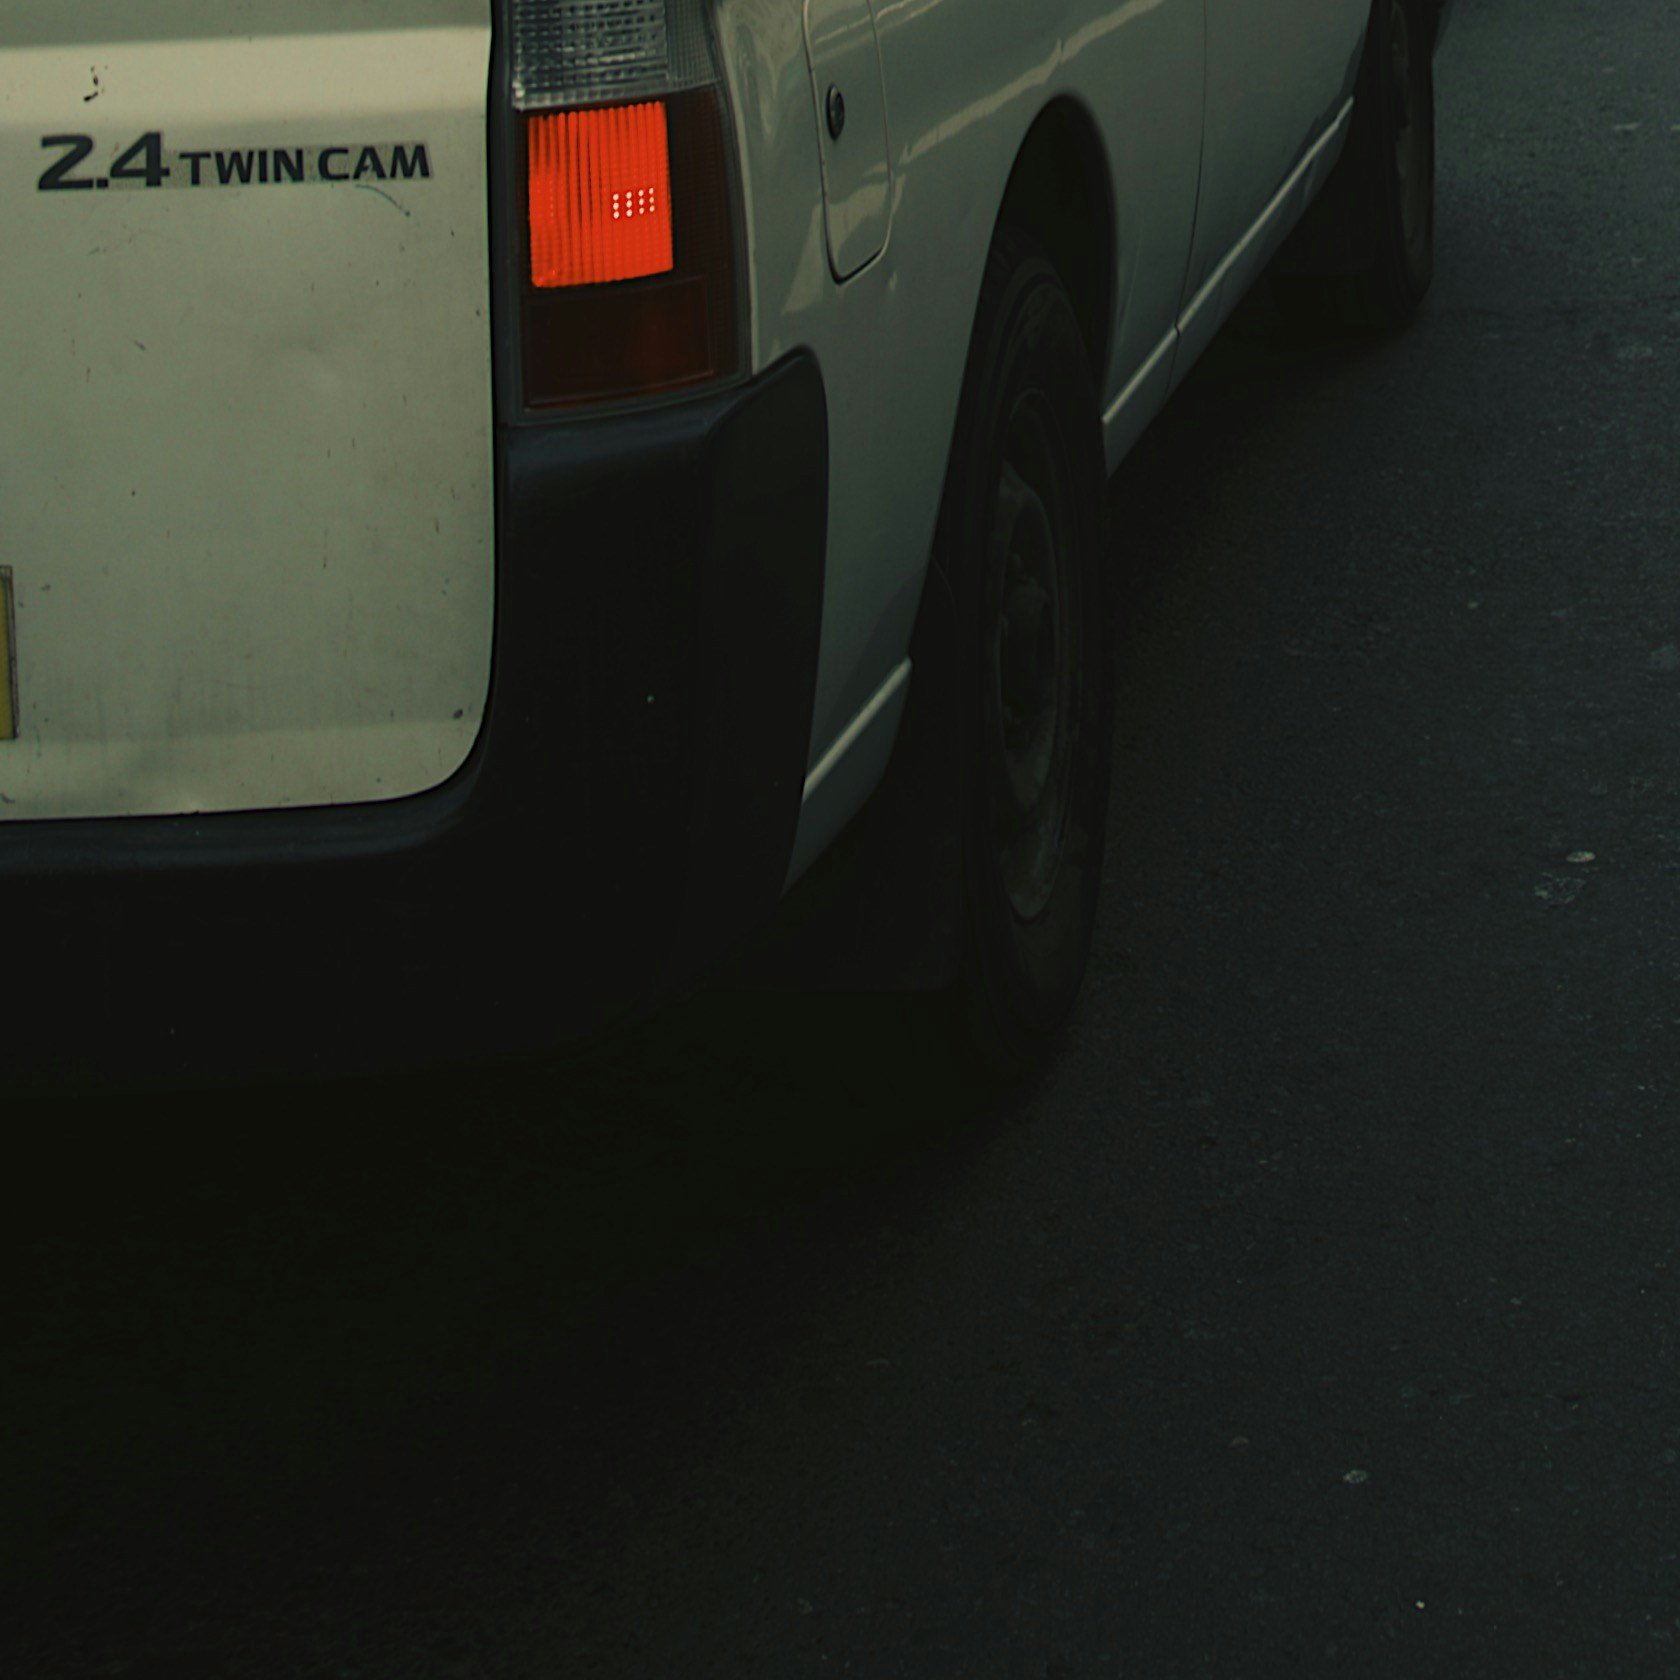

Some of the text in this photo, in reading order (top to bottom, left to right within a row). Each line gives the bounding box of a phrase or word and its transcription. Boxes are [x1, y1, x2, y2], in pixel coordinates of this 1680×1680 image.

[37, 130, 431, 191] 2.4 TWIN CAM
